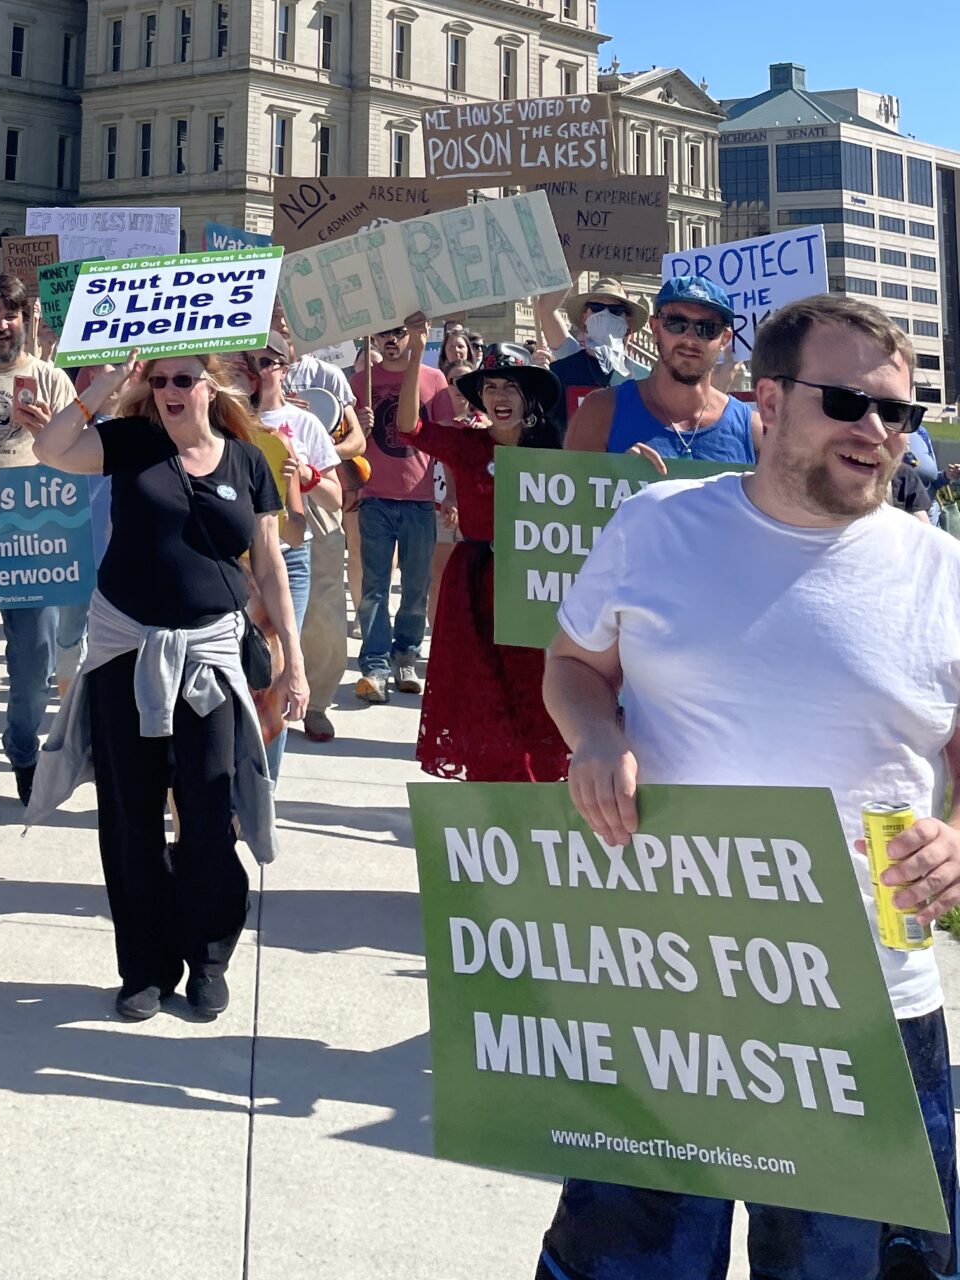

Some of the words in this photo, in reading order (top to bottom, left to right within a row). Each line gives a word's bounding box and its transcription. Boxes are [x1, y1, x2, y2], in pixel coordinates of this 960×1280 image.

[425, 109, 451, 130] MI
[457, 103, 514, 128] HOUSE
[517, 98, 564, 121] VOTED
[567, 97, 591, 114] TO
[517, 125, 553, 140] THE
[557, 118, 609, 139] GREAT
[786, 127, 828, 140] SENATE
[428, 129, 512, 175] POISON
[520, 138, 608, 170] LAKES!
[279, 179, 337, 225] NO!
[368, 185, 430, 203] ARSENIC
[585, 190, 663, 208] EXPERIENCE
[318, 202, 368, 241] CADMIUM
[577, 210, 615, 227] NOT
[8, 241, 51, 255] PROTECT
[213, 232, 261, 251] Wate
[580, 243, 660, 262] EXPERIENCE
[38, 266, 69, 281] MONEY
[89, 264, 119, 273] Keep
[121, 262, 137, 270] Oil
[140, 260, 161, 268] Out
[179, 257, 198, 265] the
[202, 254, 235, 263] Great
[238, 251, 273, 260] Lakes
[278, 230, 396, 343] GET
[402, 195, 571, 312] REAL
[672, 234, 819, 286] PROTECT
[49, 280, 74, 296] SAVE
[86, 273, 161, 295] Shut
[173, 268, 266, 287] Down
[42, 300, 61, 314] THE
[125, 291, 214, 314] Line
[228, 285, 254, 305] 5
[727, 287, 772, 310] THE
[81, 310, 252, 343] Pipeline
[66, 337, 257, 362] www.OilaWaterDontMix.org
[24, 476, 77, 509] Life
[519, 471, 576, 506] NO
[588, 477, 649, 509] TA
[444, 826, 520, 886] NO
[531, 829, 824, 904] TAXPAYER
[449, 916, 699, 993] DOLLARS
[708, 934, 841, 1009] FOR
[473, 1011, 618, 1085] MINE
[632, 1025, 865, 1116] WASTE
[551, 1129, 796, 1175] www.ProtectThePorkies.com
